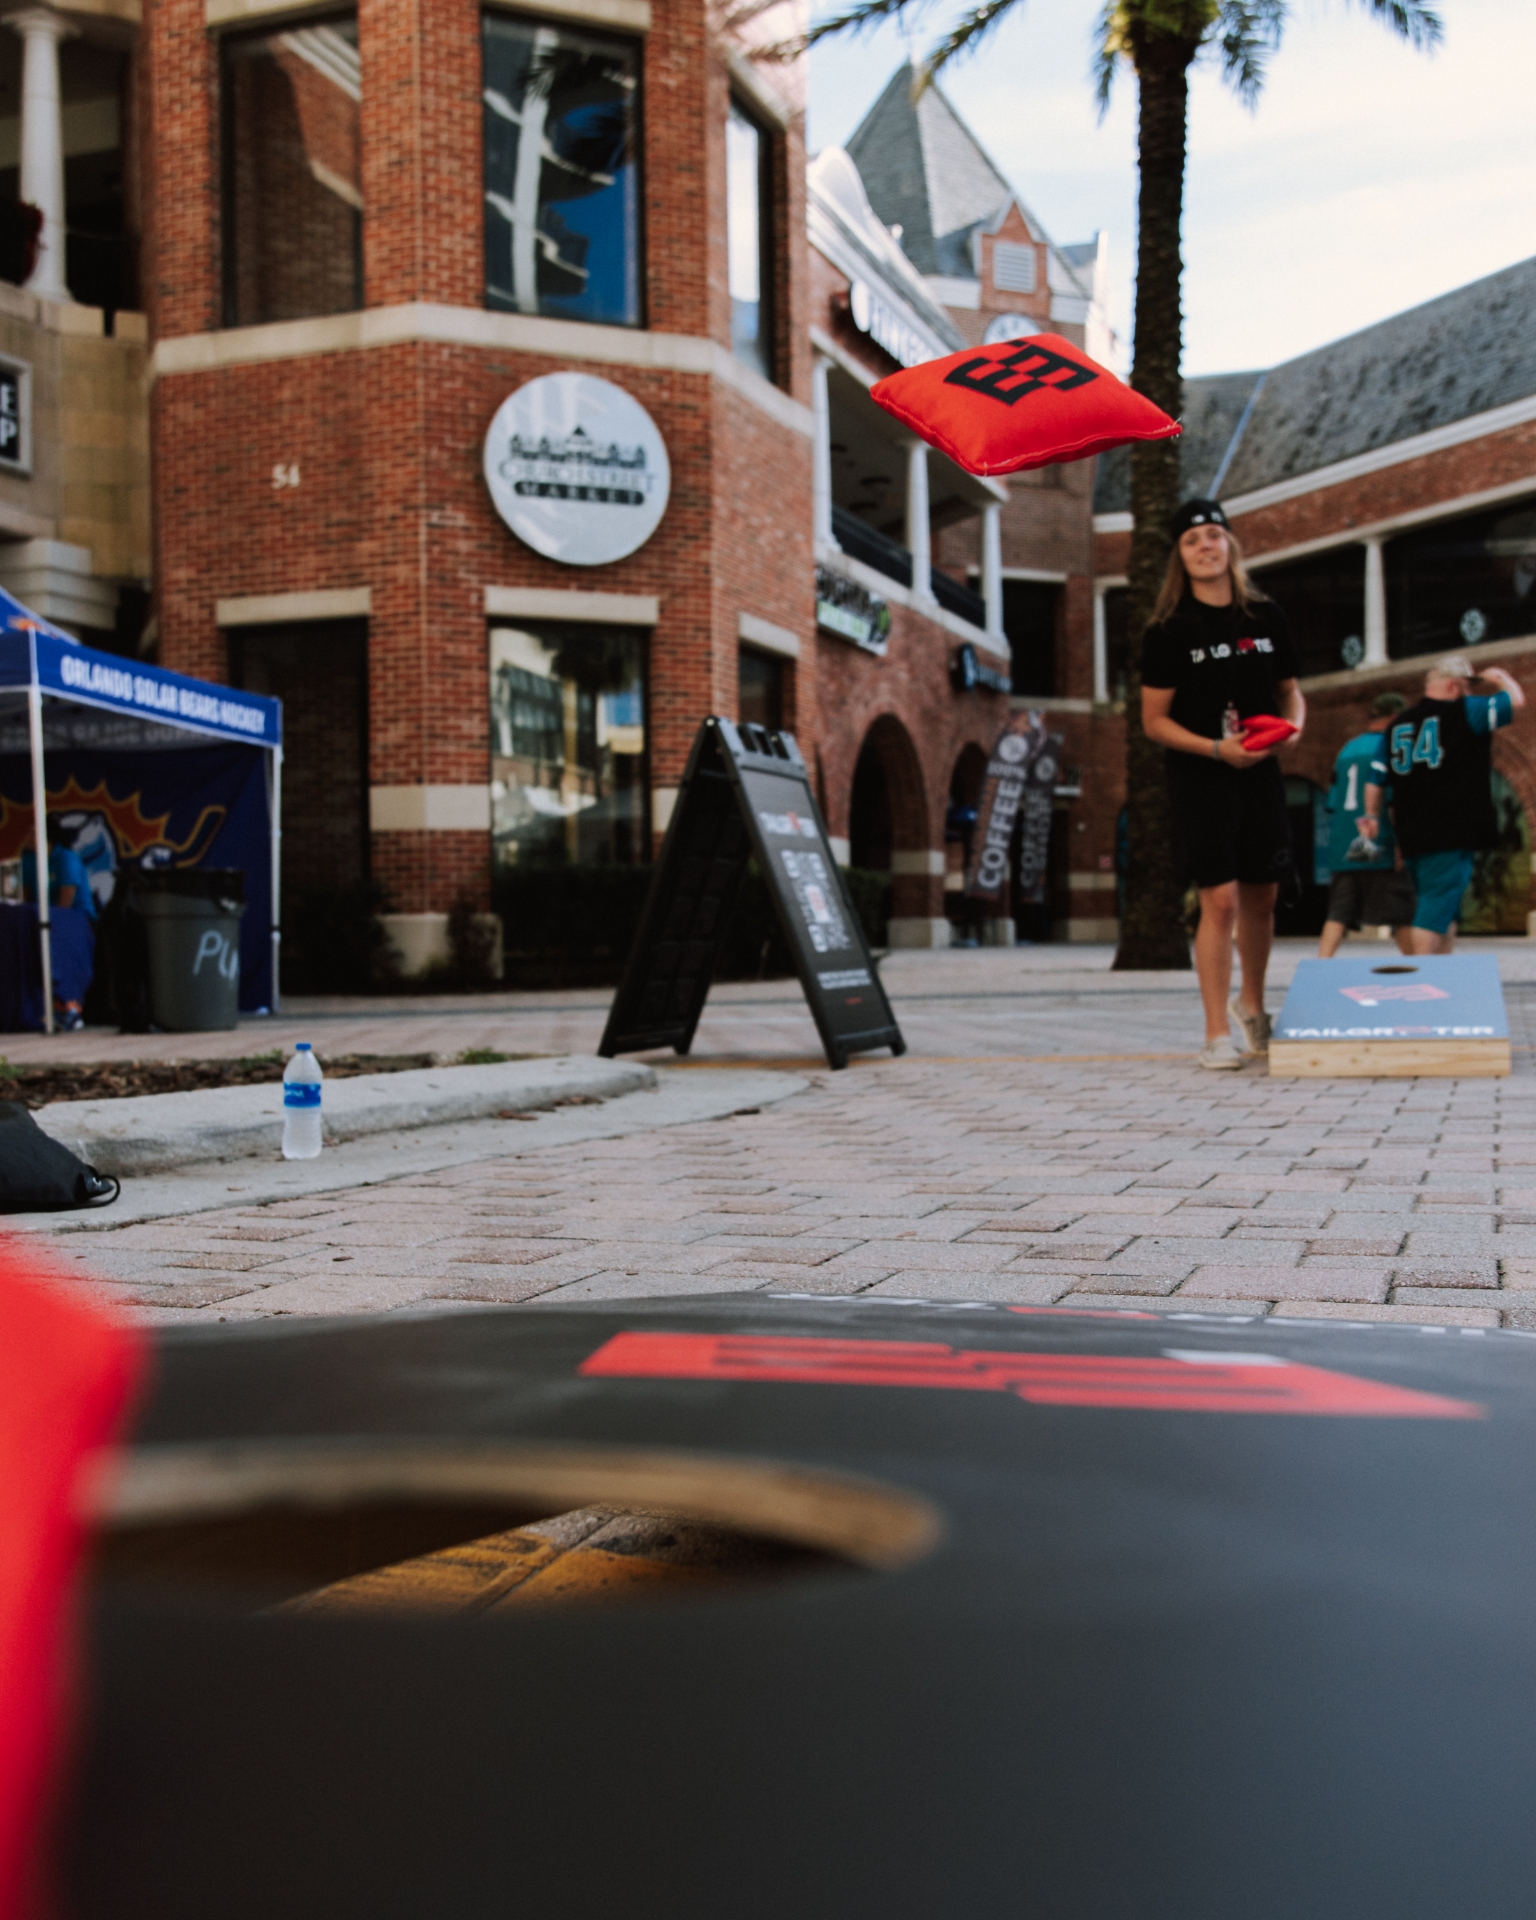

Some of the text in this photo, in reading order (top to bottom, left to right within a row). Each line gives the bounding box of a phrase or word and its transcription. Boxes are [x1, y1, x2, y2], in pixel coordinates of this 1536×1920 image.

[60, 654, 266, 735] ORLANDO SOLAR BEARS HOCKEY
[1390, 715, 1445, 776] 54
[1343, 763, 1359, 811] 1
[977, 777, 1025, 889] COFFEE
